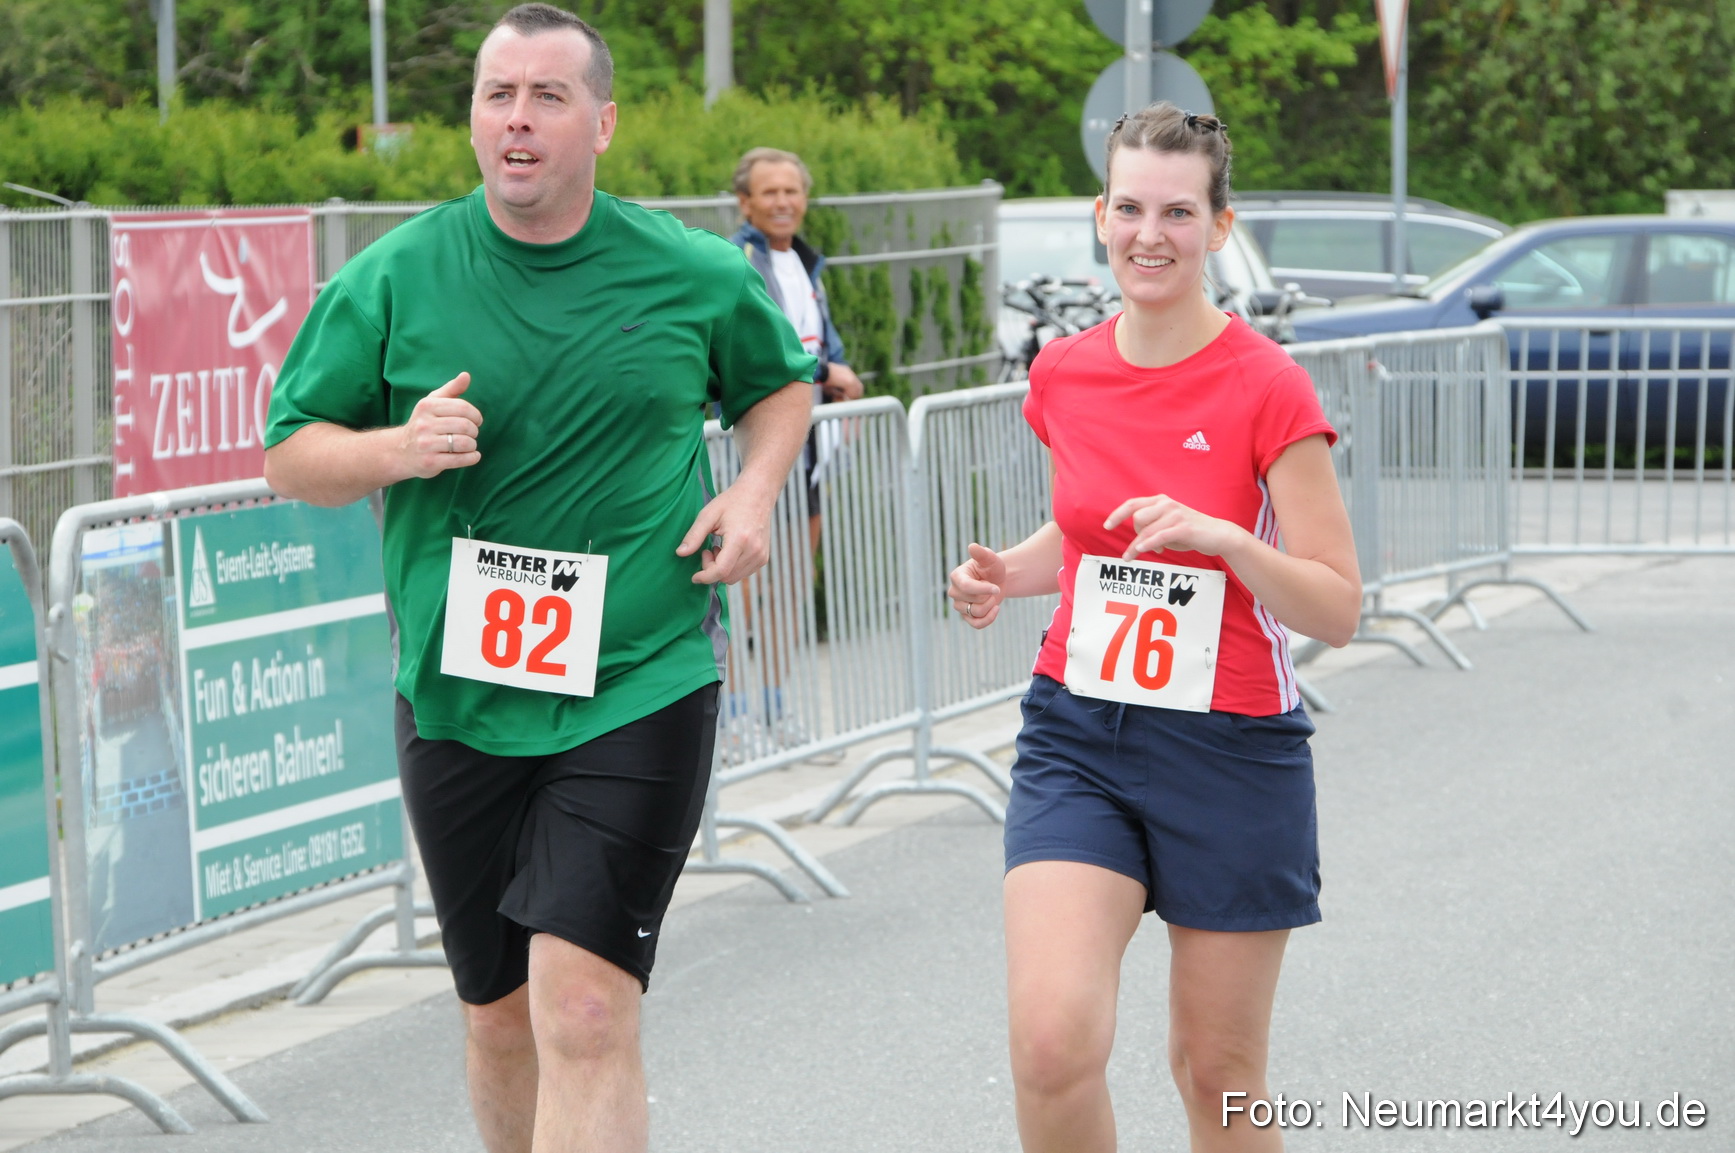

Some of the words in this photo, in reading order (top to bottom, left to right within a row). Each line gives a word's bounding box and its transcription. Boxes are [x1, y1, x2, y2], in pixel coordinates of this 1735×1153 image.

[114, 232, 134, 500] ITLOS
[150, 363, 279, 461] ZEITLO
[1183, 442, 1211, 451] adidas
[215, 541, 315, 584] Event-Leit-Systeme
[477, 548, 547, 573] MEYER
[477, 565, 547, 586] WERBUNG
[1100, 564, 1164, 587] MEYER
[1099, 581, 1163, 600] WERBUNG
[481, 588, 572, 676] 82
[1100, 600, 1177, 690] 76
[194, 669, 229, 723] Fun
[232, 661, 248, 716] &
[250, 650, 306, 712] Action
[307, 643, 326, 698] in
[199, 742, 272, 806] sicheren
[274, 718, 344, 786] Bahnen!
[205, 861, 233, 899] Miet
[233, 857, 243, 891] &
[244, 847, 282, 888] Service
[282, 841, 308, 876] Line:
